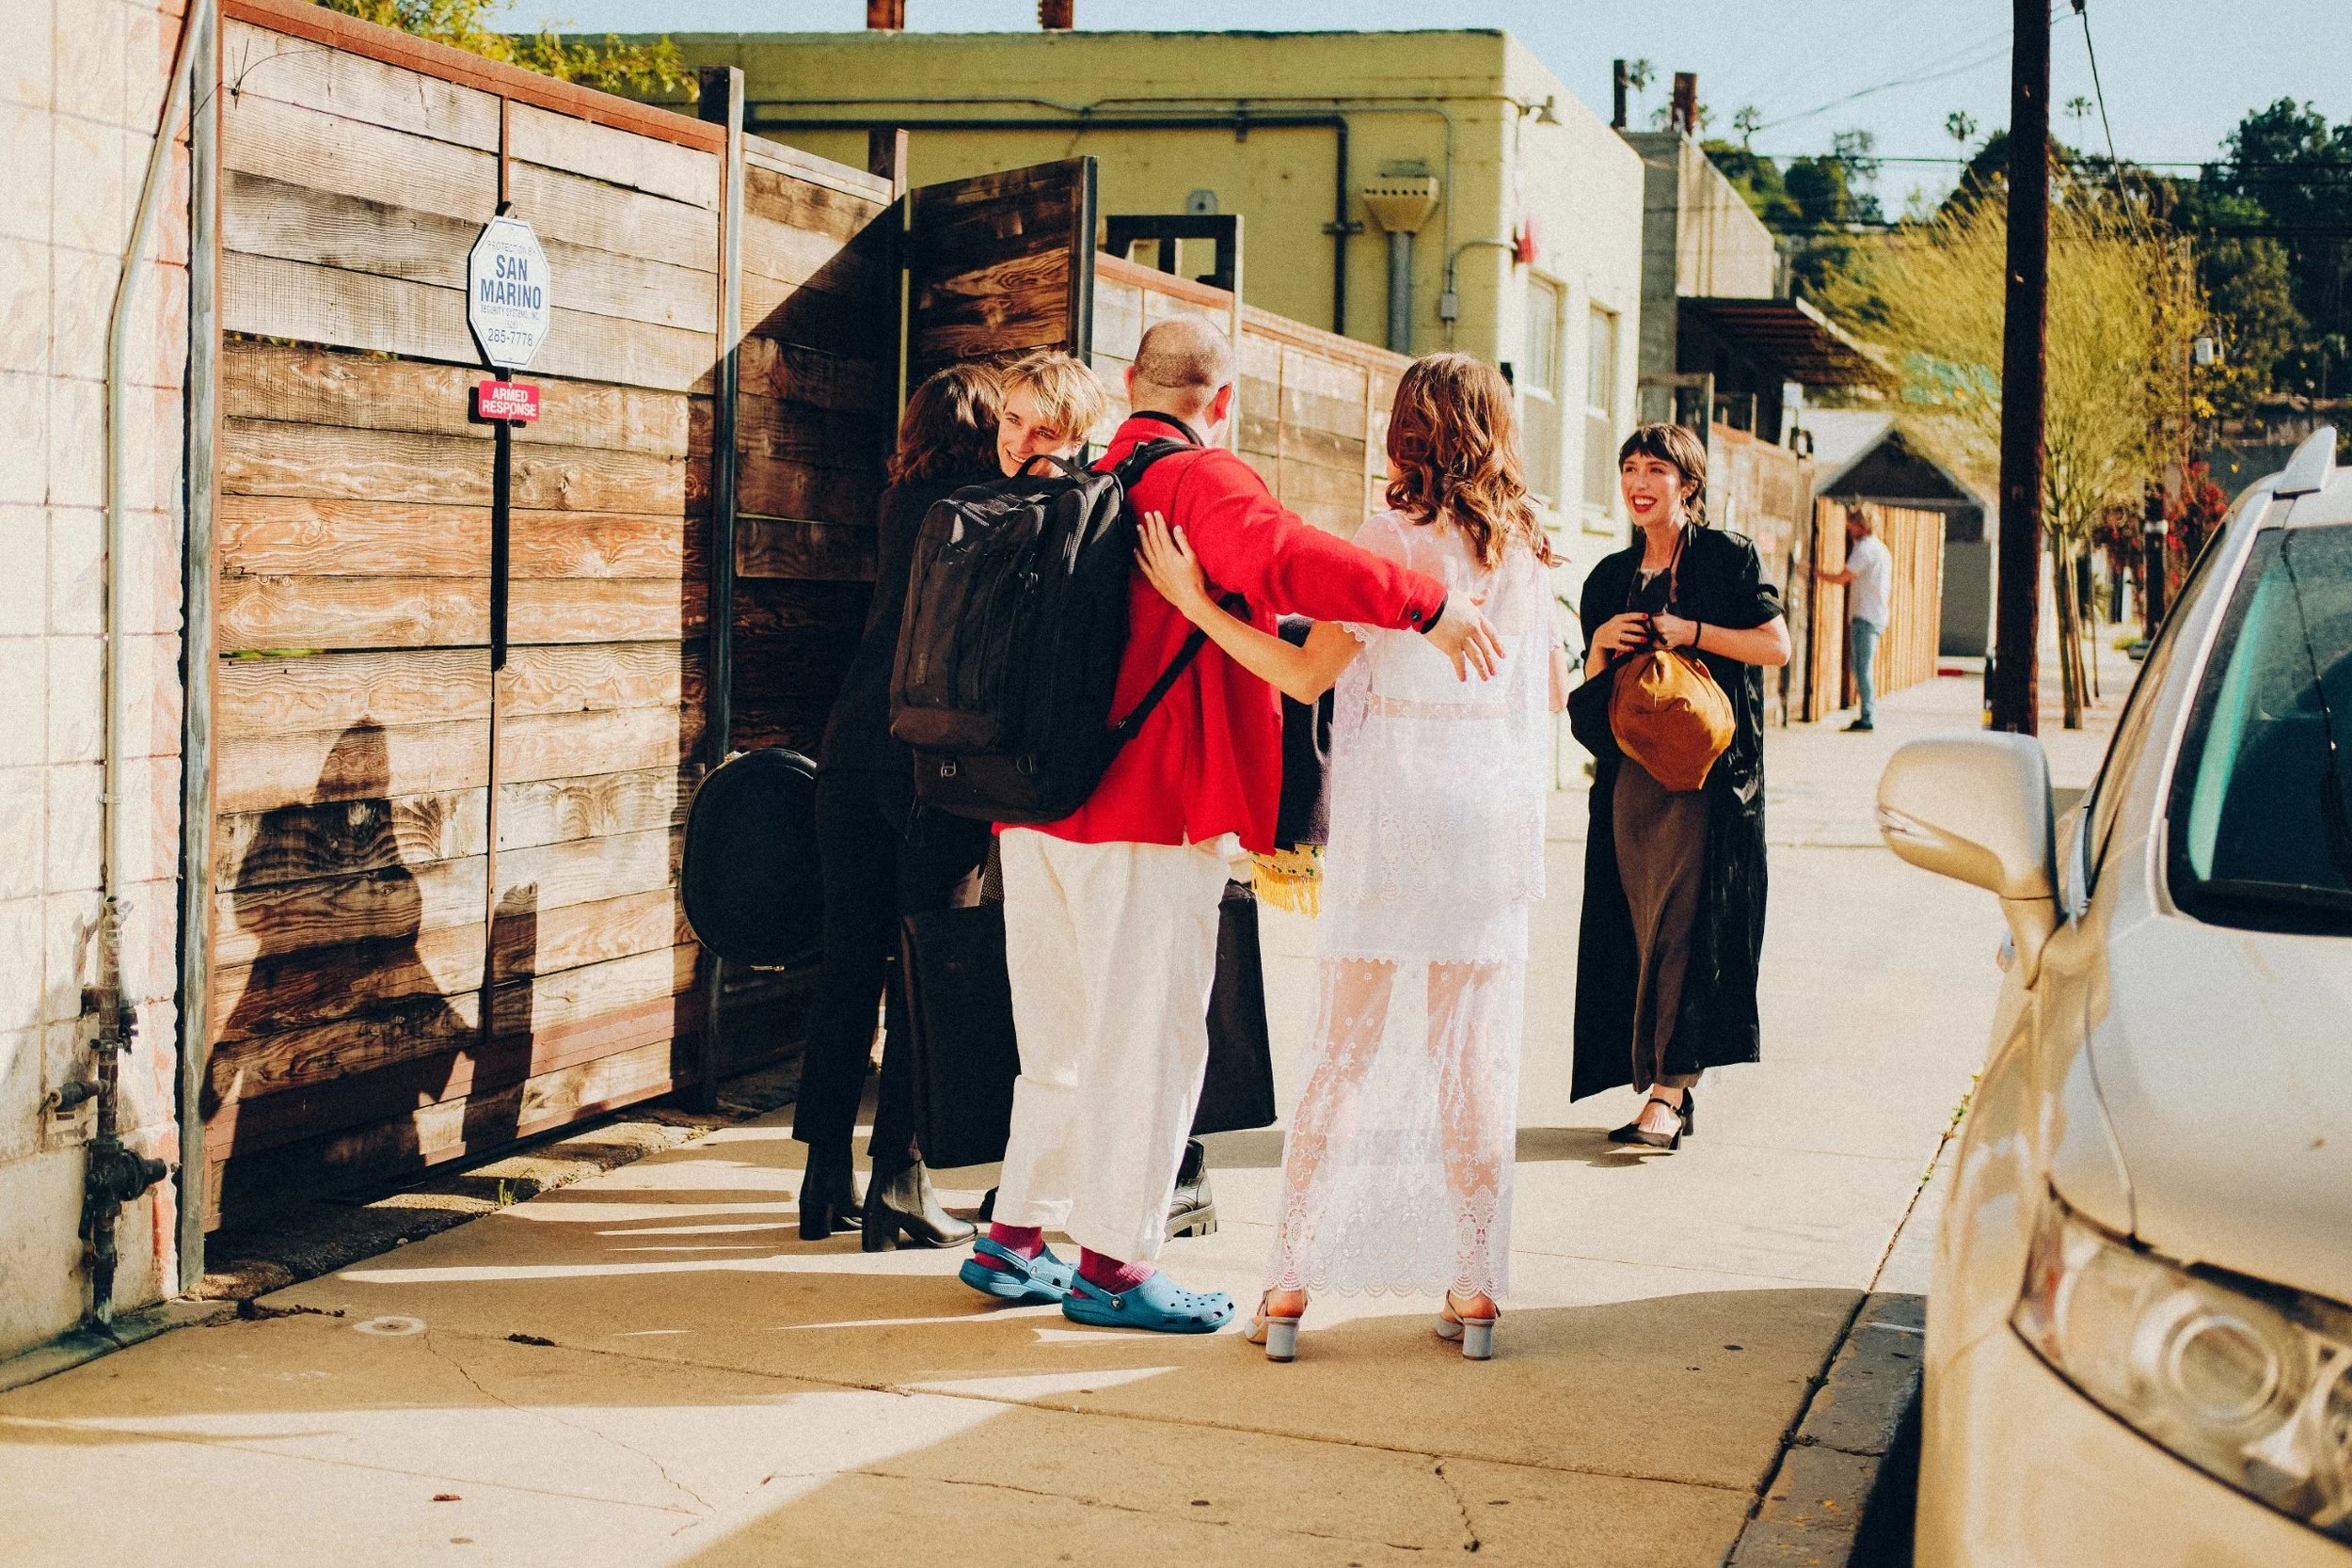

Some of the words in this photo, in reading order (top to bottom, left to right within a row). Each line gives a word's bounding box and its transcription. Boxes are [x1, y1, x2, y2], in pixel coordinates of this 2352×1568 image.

[496, 254, 527, 282] SAN
[481, 278, 541, 310] MARINO
[487, 327, 532, 347] 285-7778
[492, 387, 528, 404] ARMED
[482, 399, 536, 417] RESPONSE
